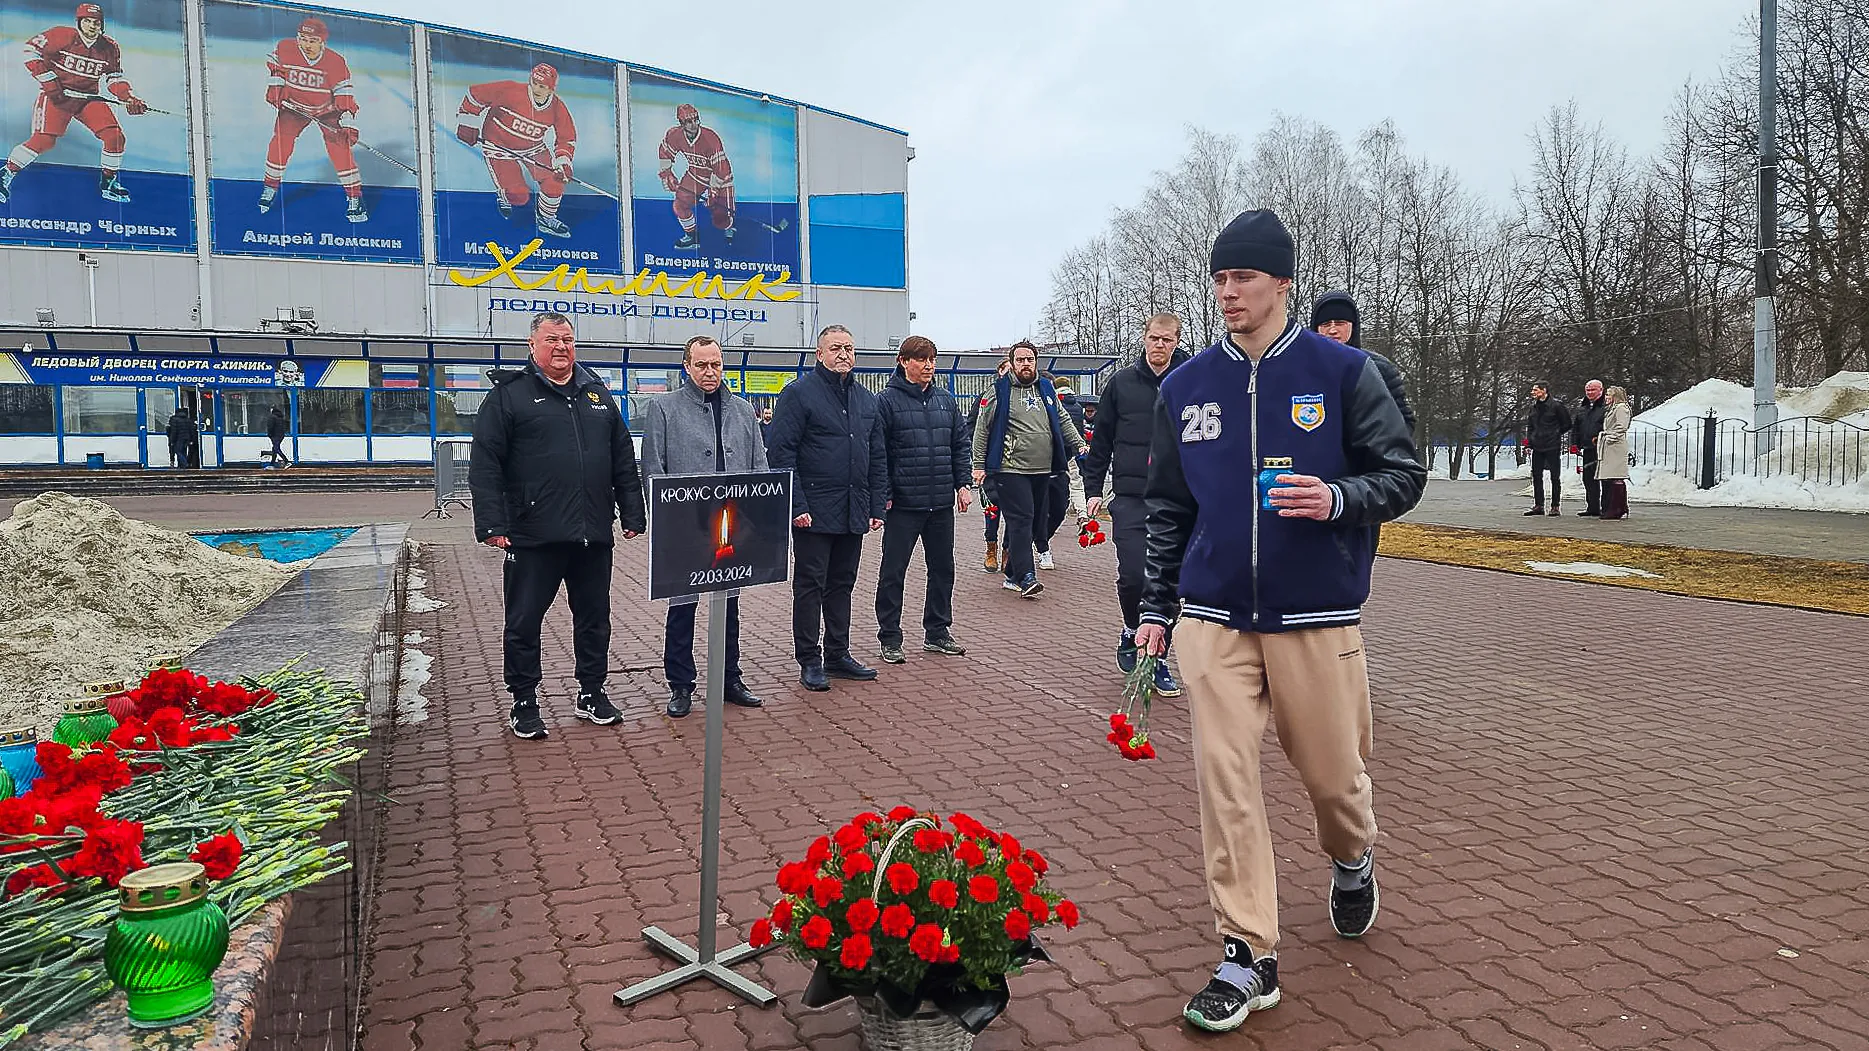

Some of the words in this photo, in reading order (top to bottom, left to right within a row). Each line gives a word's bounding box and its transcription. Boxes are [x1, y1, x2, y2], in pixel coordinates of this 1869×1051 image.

[288, 69, 325, 88] СССР
[511, 118, 542, 137] СССР
[98, 219, 177, 237] Черных
[243, 230, 314, 247] Андрей
[319, 233, 402, 249] Ломакин
[449, 238, 802, 302] Химик
[644, 253, 709, 269] Валерий
[714, 257, 790, 273] Зелепукин
[487, 298, 638, 316] ледовый
[652, 304, 768, 324] дворец
[32, 356, 100, 368] ЛЕДОВЫЙ
[103, 358, 157, 370] ДВОРЕЦ
[161, 359, 210, 370] СПОРТА
[212, 360, 273, 371] «ХИМИК»
[90, 374, 106, 382] им.
[109, 373, 153, 382] Николая
[155, 373, 216, 383] Семёновича
[218, 375, 272, 384] Эпштейна
[1181, 402, 1222, 443] 26
[660, 485, 711, 503] КРОКУС
[714, 483, 748, 500] СИТИ
[751, 481, 784, 497] ХОЛЛ
[689, 565, 753, 586] 22.03.2024
